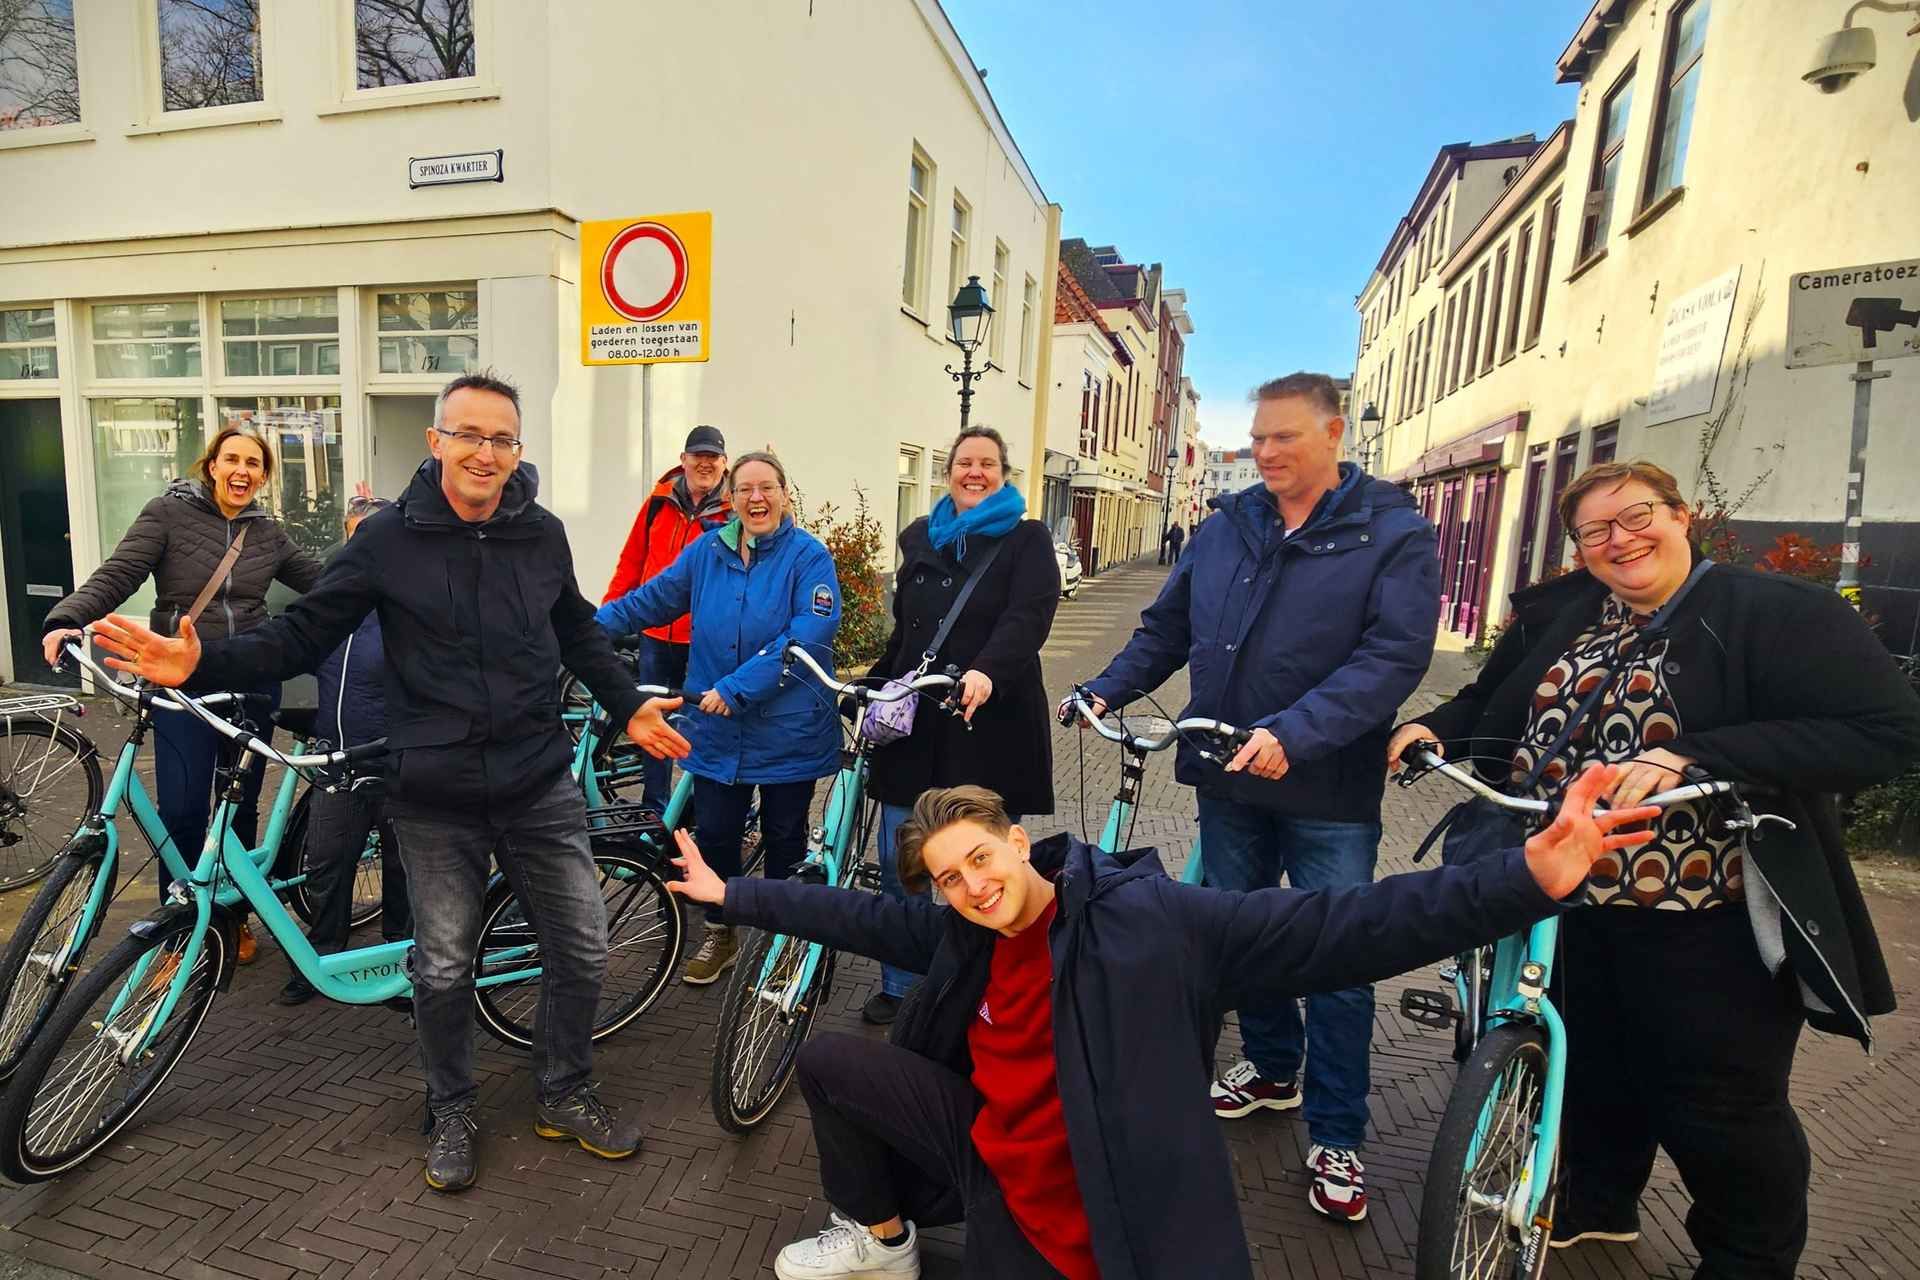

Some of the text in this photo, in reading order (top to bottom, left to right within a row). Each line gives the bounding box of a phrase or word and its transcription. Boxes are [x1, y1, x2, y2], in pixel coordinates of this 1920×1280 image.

[419, 160, 488, 177] SPINOZA KWARTIER
[591, 322, 698, 336] Laden en lossen van
[591, 334, 699, 349] goederen toegestaan
[607, 347, 681, 359] 08.00-12.00 h
